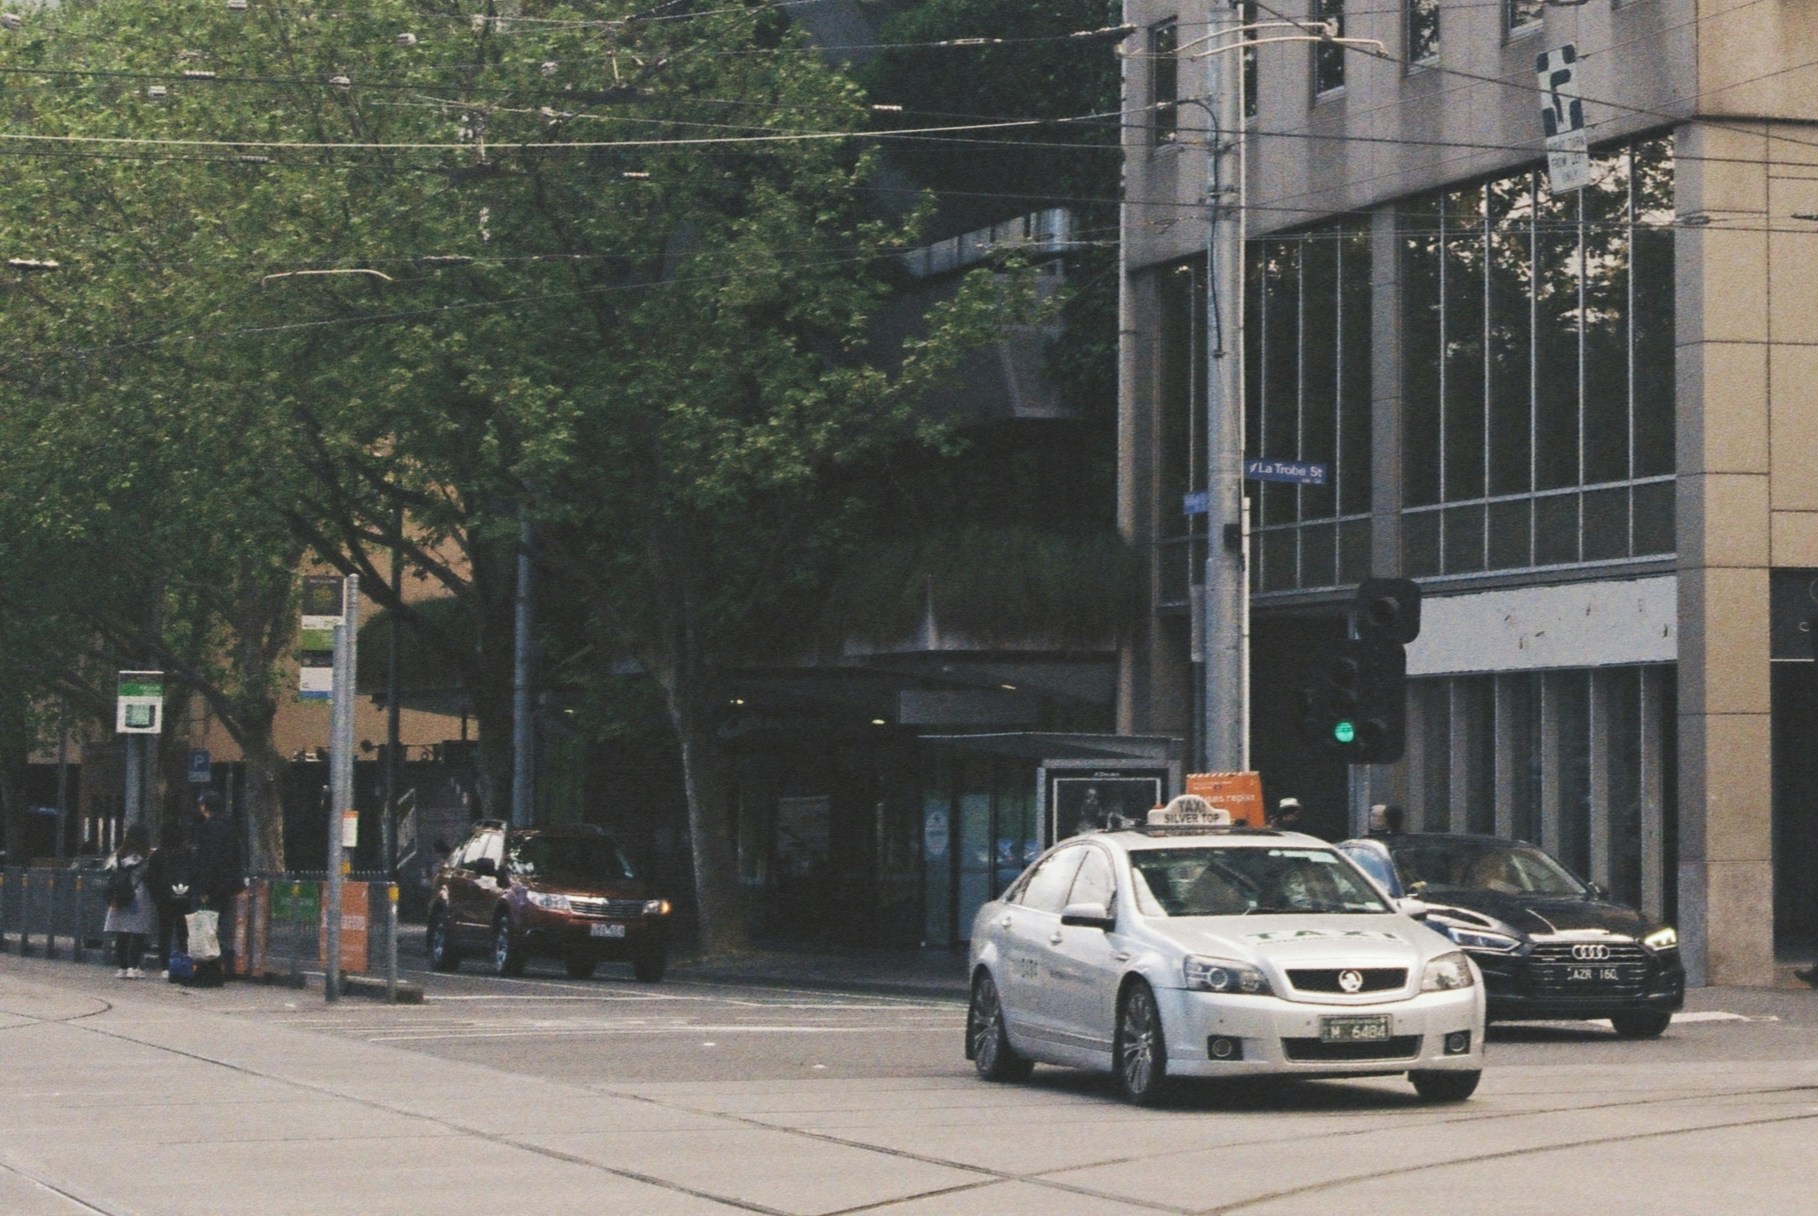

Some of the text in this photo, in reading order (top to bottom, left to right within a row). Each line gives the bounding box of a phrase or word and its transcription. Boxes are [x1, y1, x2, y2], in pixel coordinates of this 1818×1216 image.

[1258, 462, 1323, 478] La Trobe St
[1178, 799, 1207, 813] TAXI
[1164, 813, 1220, 823] SILVER TOP
